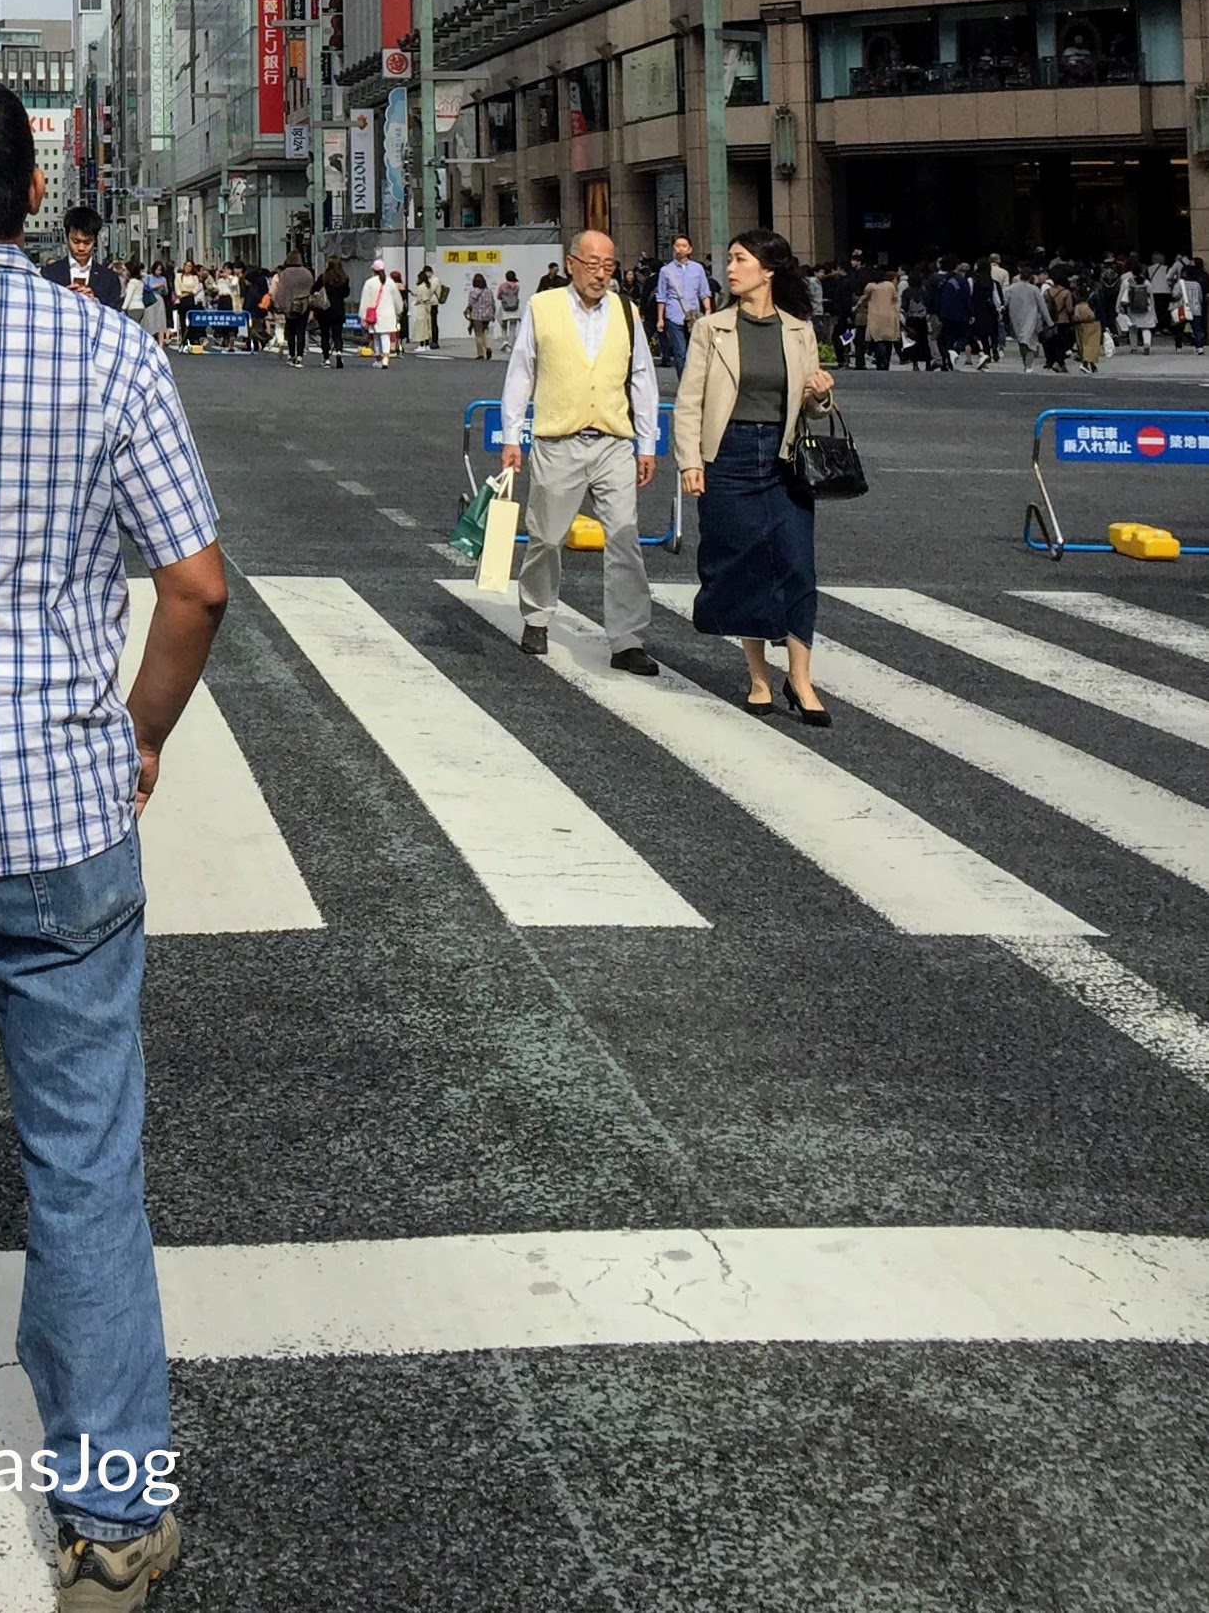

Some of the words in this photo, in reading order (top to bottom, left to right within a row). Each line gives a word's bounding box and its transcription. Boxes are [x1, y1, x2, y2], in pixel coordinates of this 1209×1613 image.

[1077, 426, 1118, 440] 自転車
[1063, 440, 1132, 454] 乗入れ禁止
